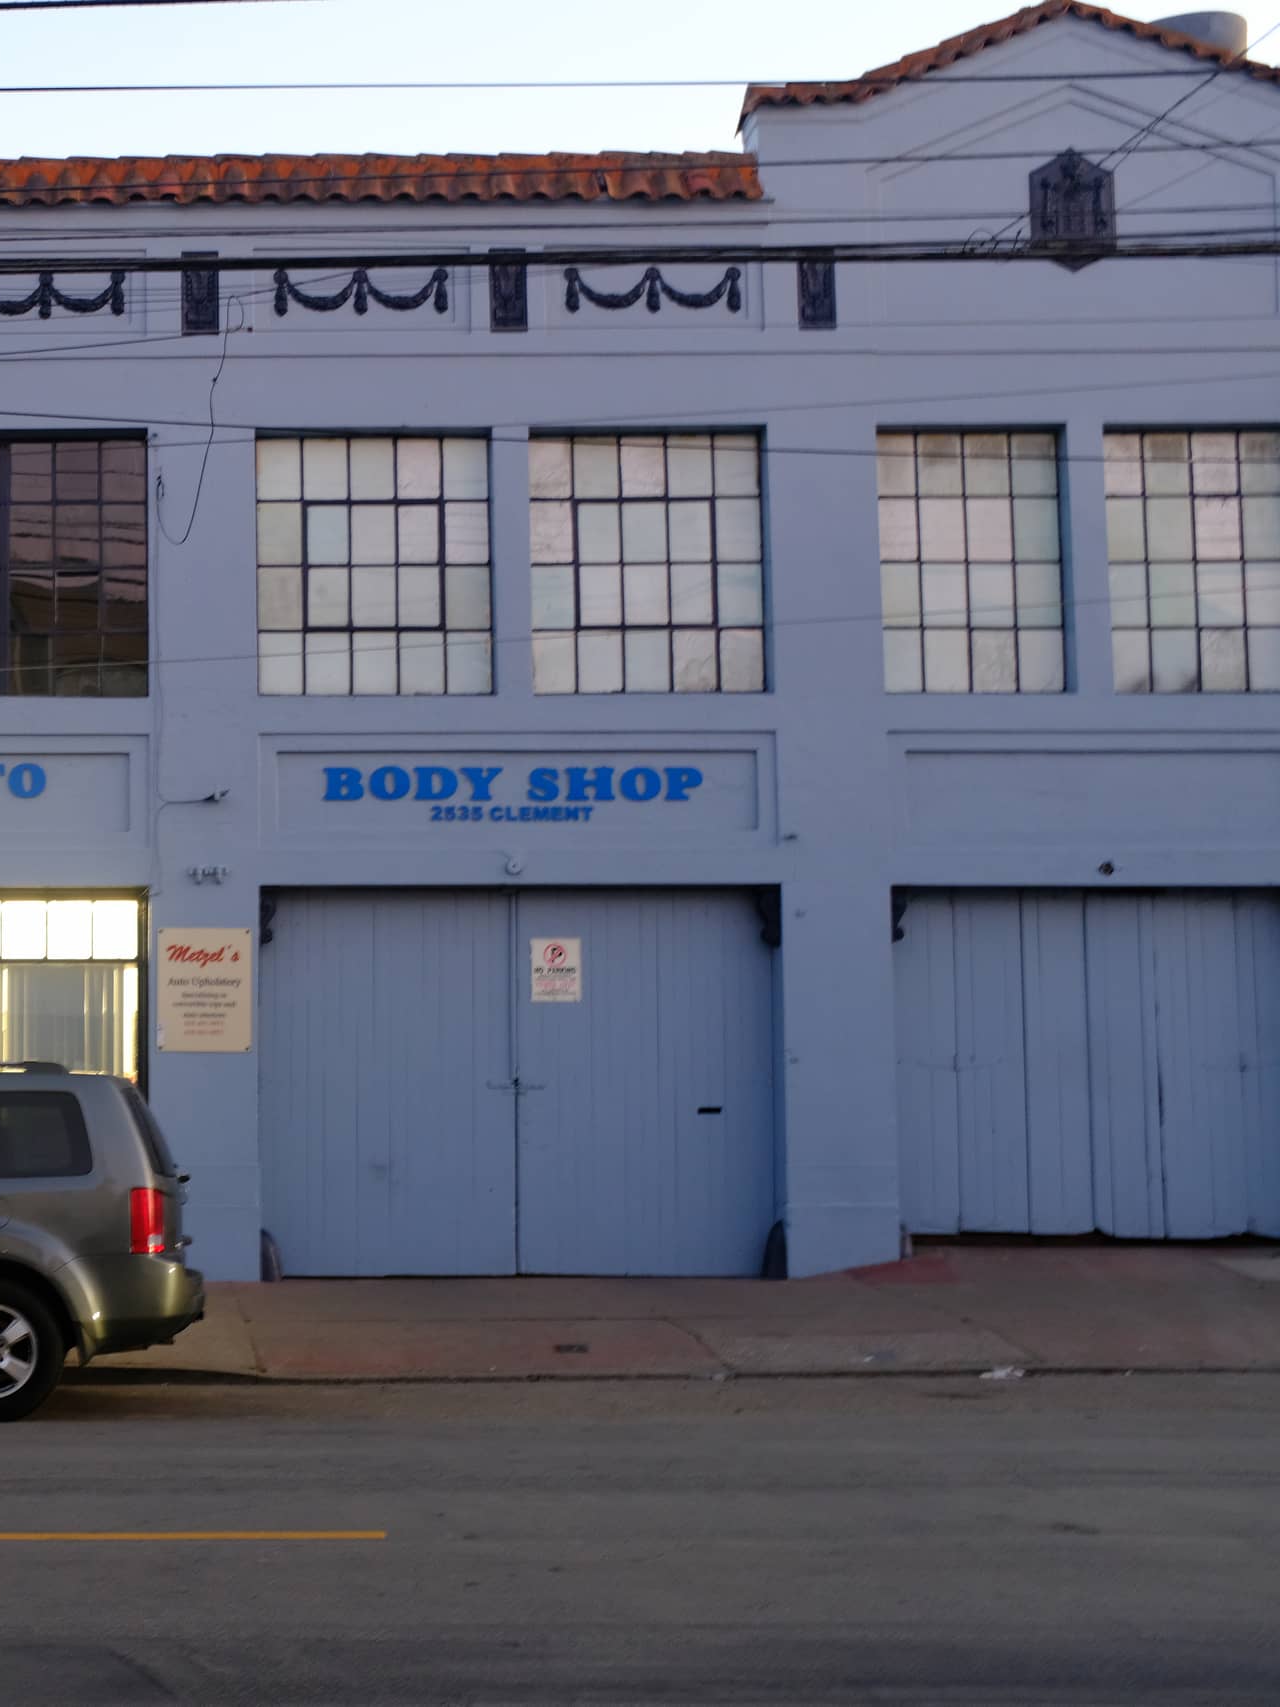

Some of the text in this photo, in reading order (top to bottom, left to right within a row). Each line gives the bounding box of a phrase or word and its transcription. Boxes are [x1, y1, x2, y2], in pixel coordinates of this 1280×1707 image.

[323, 766, 704, 802] BODY SHOP
[431, 805, 594, 822] 2535 CLEMENT
[166, 945, 240, 969] Metzel's
